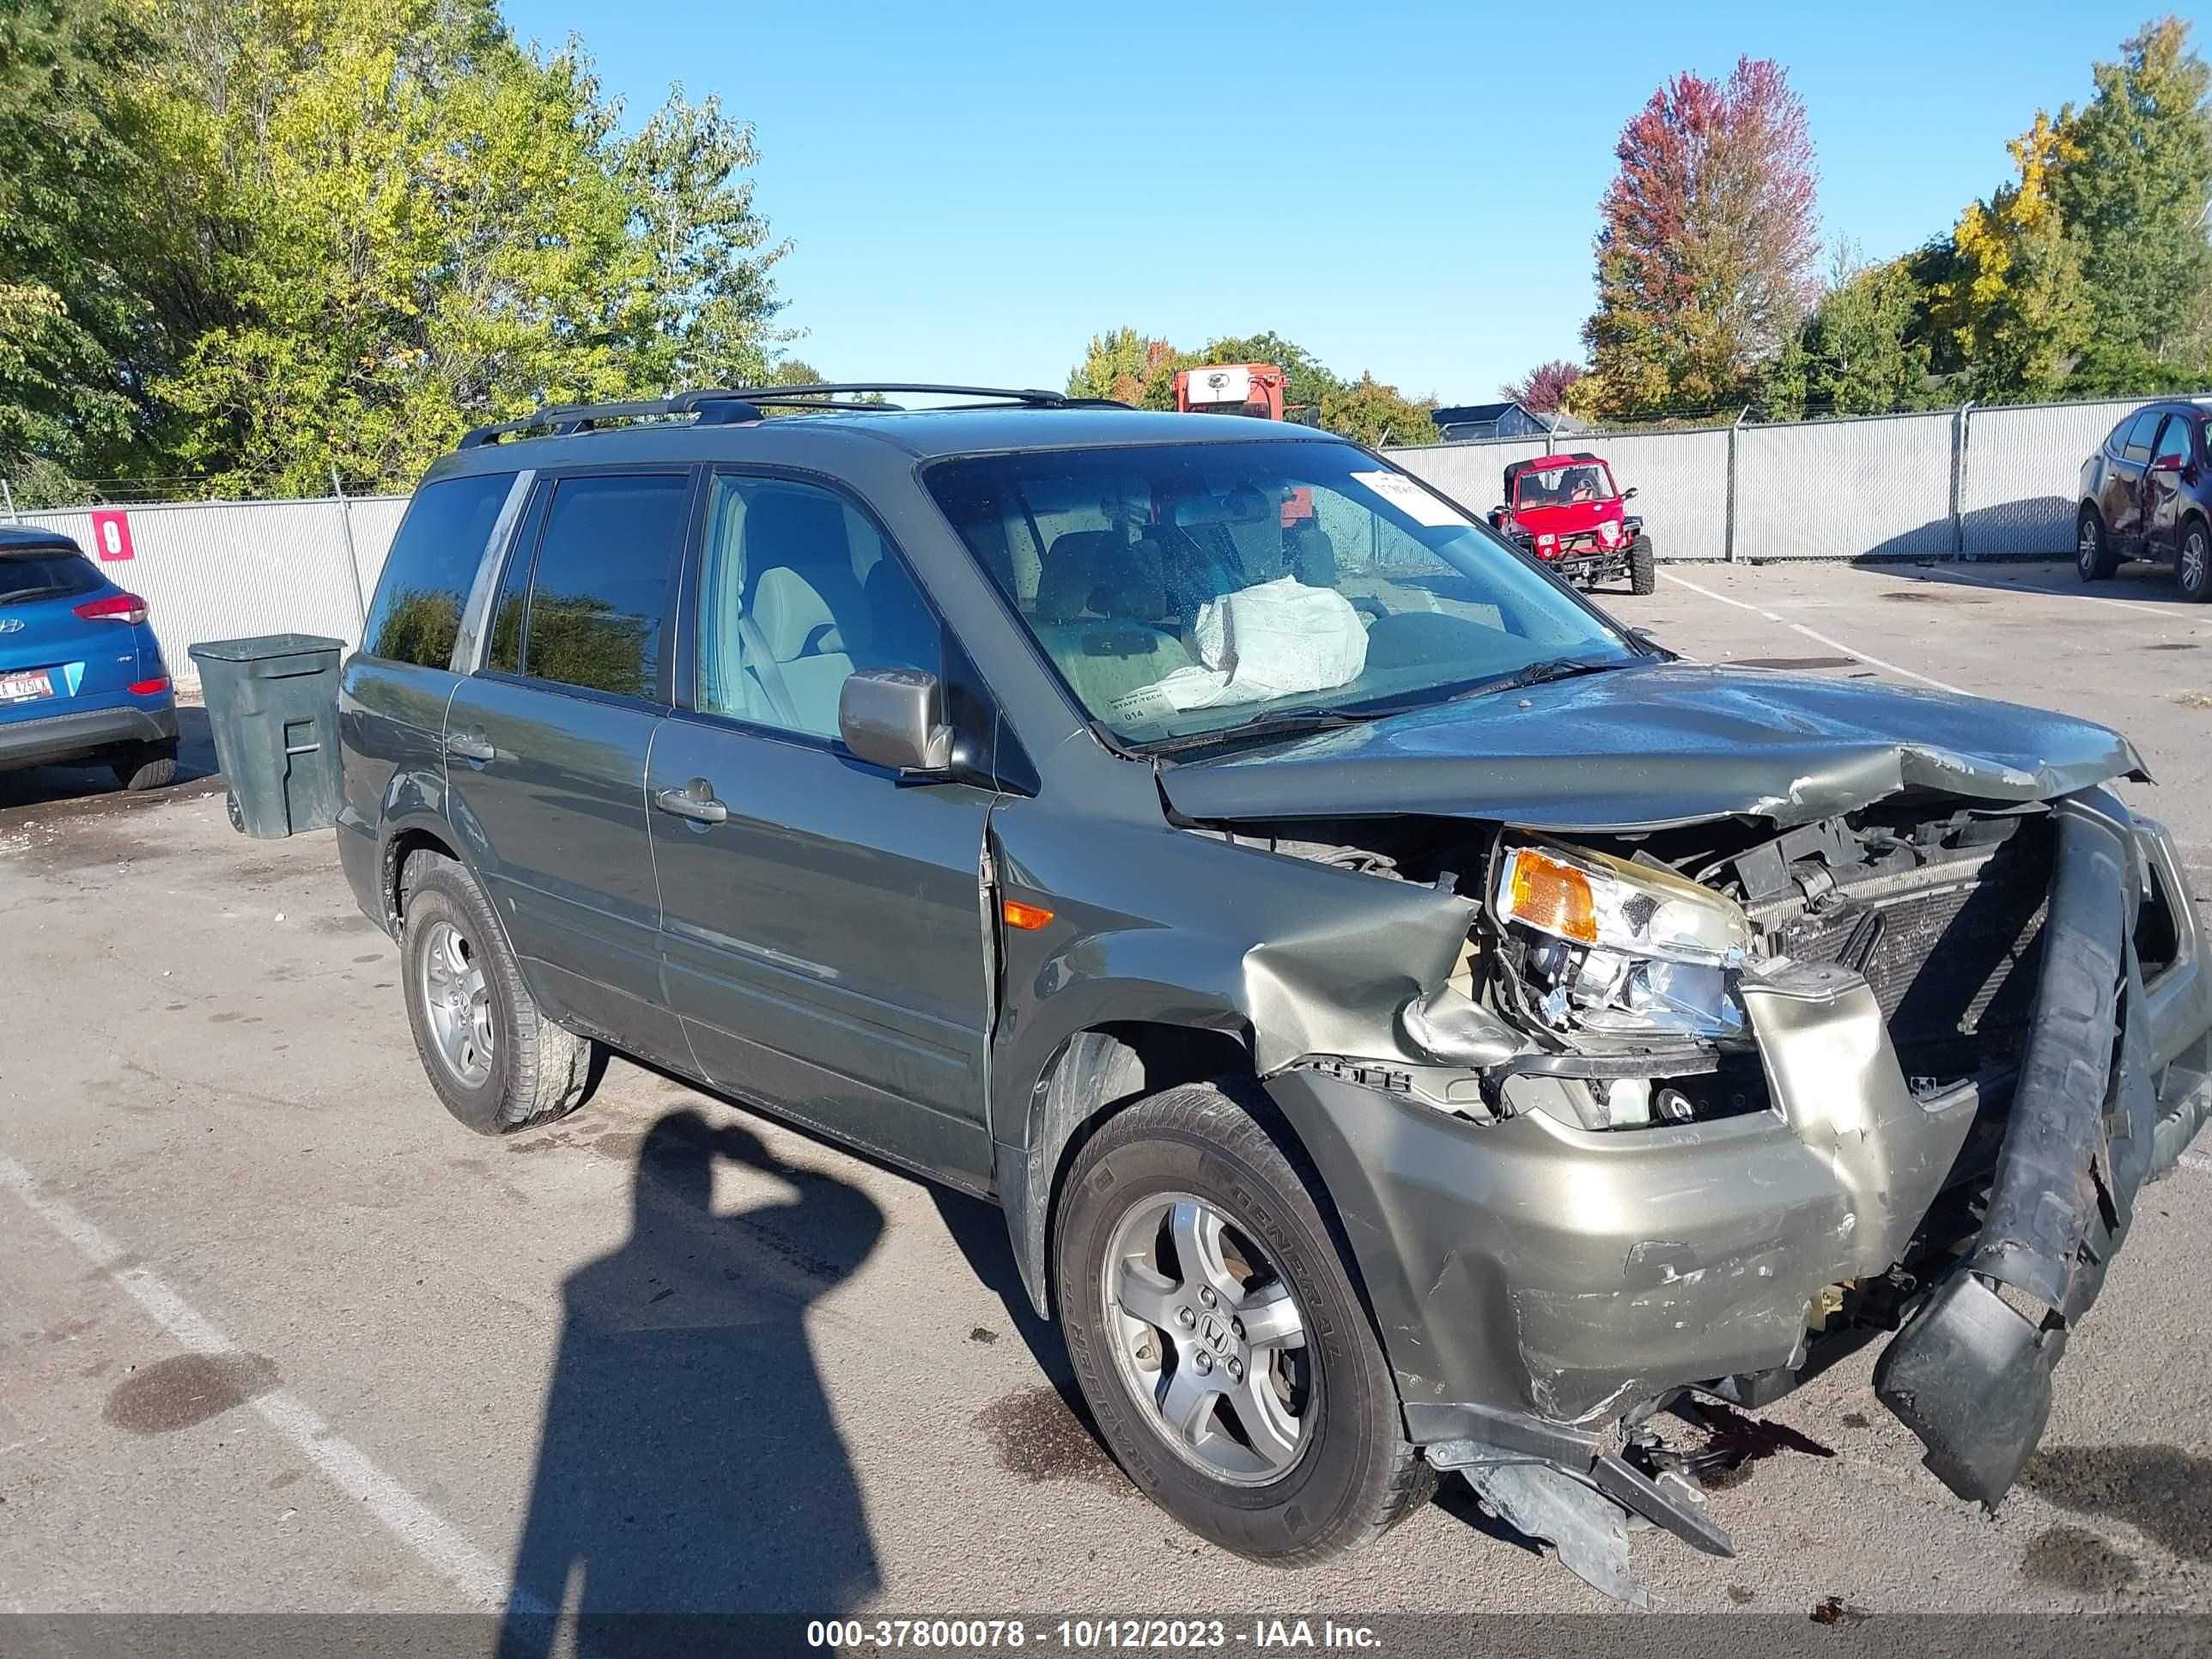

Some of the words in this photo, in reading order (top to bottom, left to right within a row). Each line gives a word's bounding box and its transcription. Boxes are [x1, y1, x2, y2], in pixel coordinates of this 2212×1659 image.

[1124, 709, 1144, 721] 014
[1233, 1186, 1346, 1368] GENERAL
[1070, 1322, 1163, 1489] GRABBER
